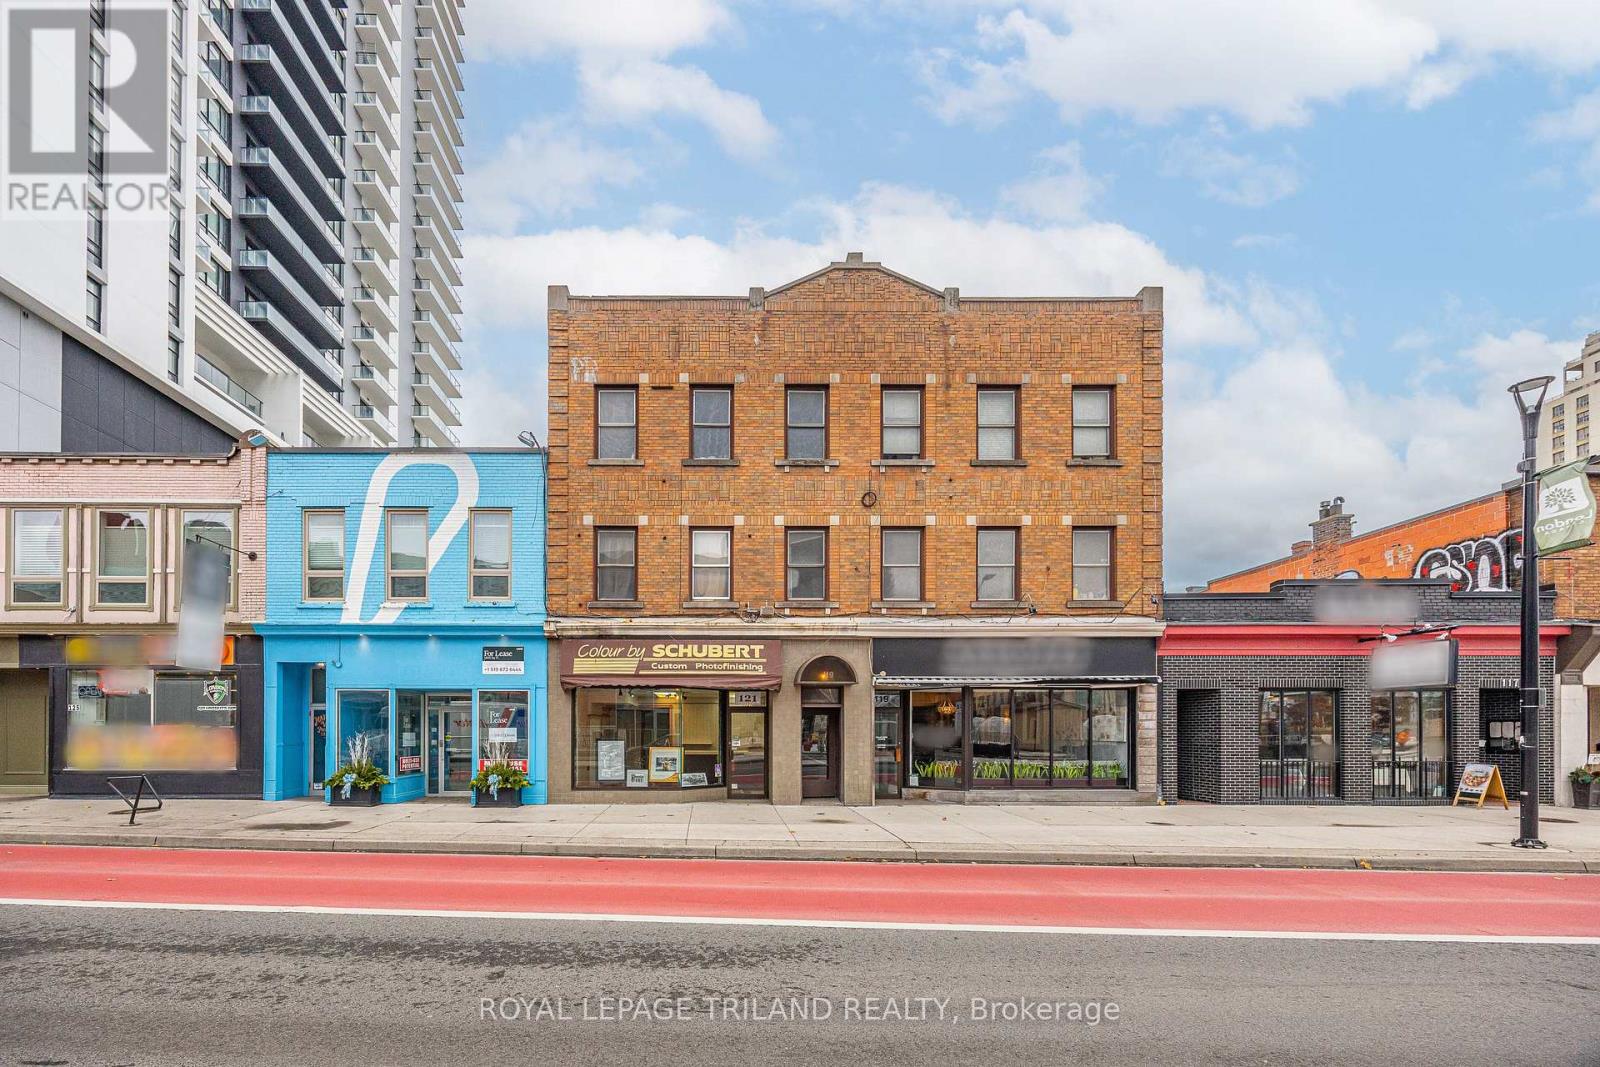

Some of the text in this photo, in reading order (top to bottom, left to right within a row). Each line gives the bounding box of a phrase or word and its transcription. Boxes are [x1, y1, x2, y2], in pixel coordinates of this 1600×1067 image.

[577, 644, 765, 660] Colour by SCHUBERT
[651, 662, 763, 672] Custom Photofinishing
[1502, 678, 1519, 687] 117
[739, 694, 758, 702] 121
[489, 710, 500, 718] For
